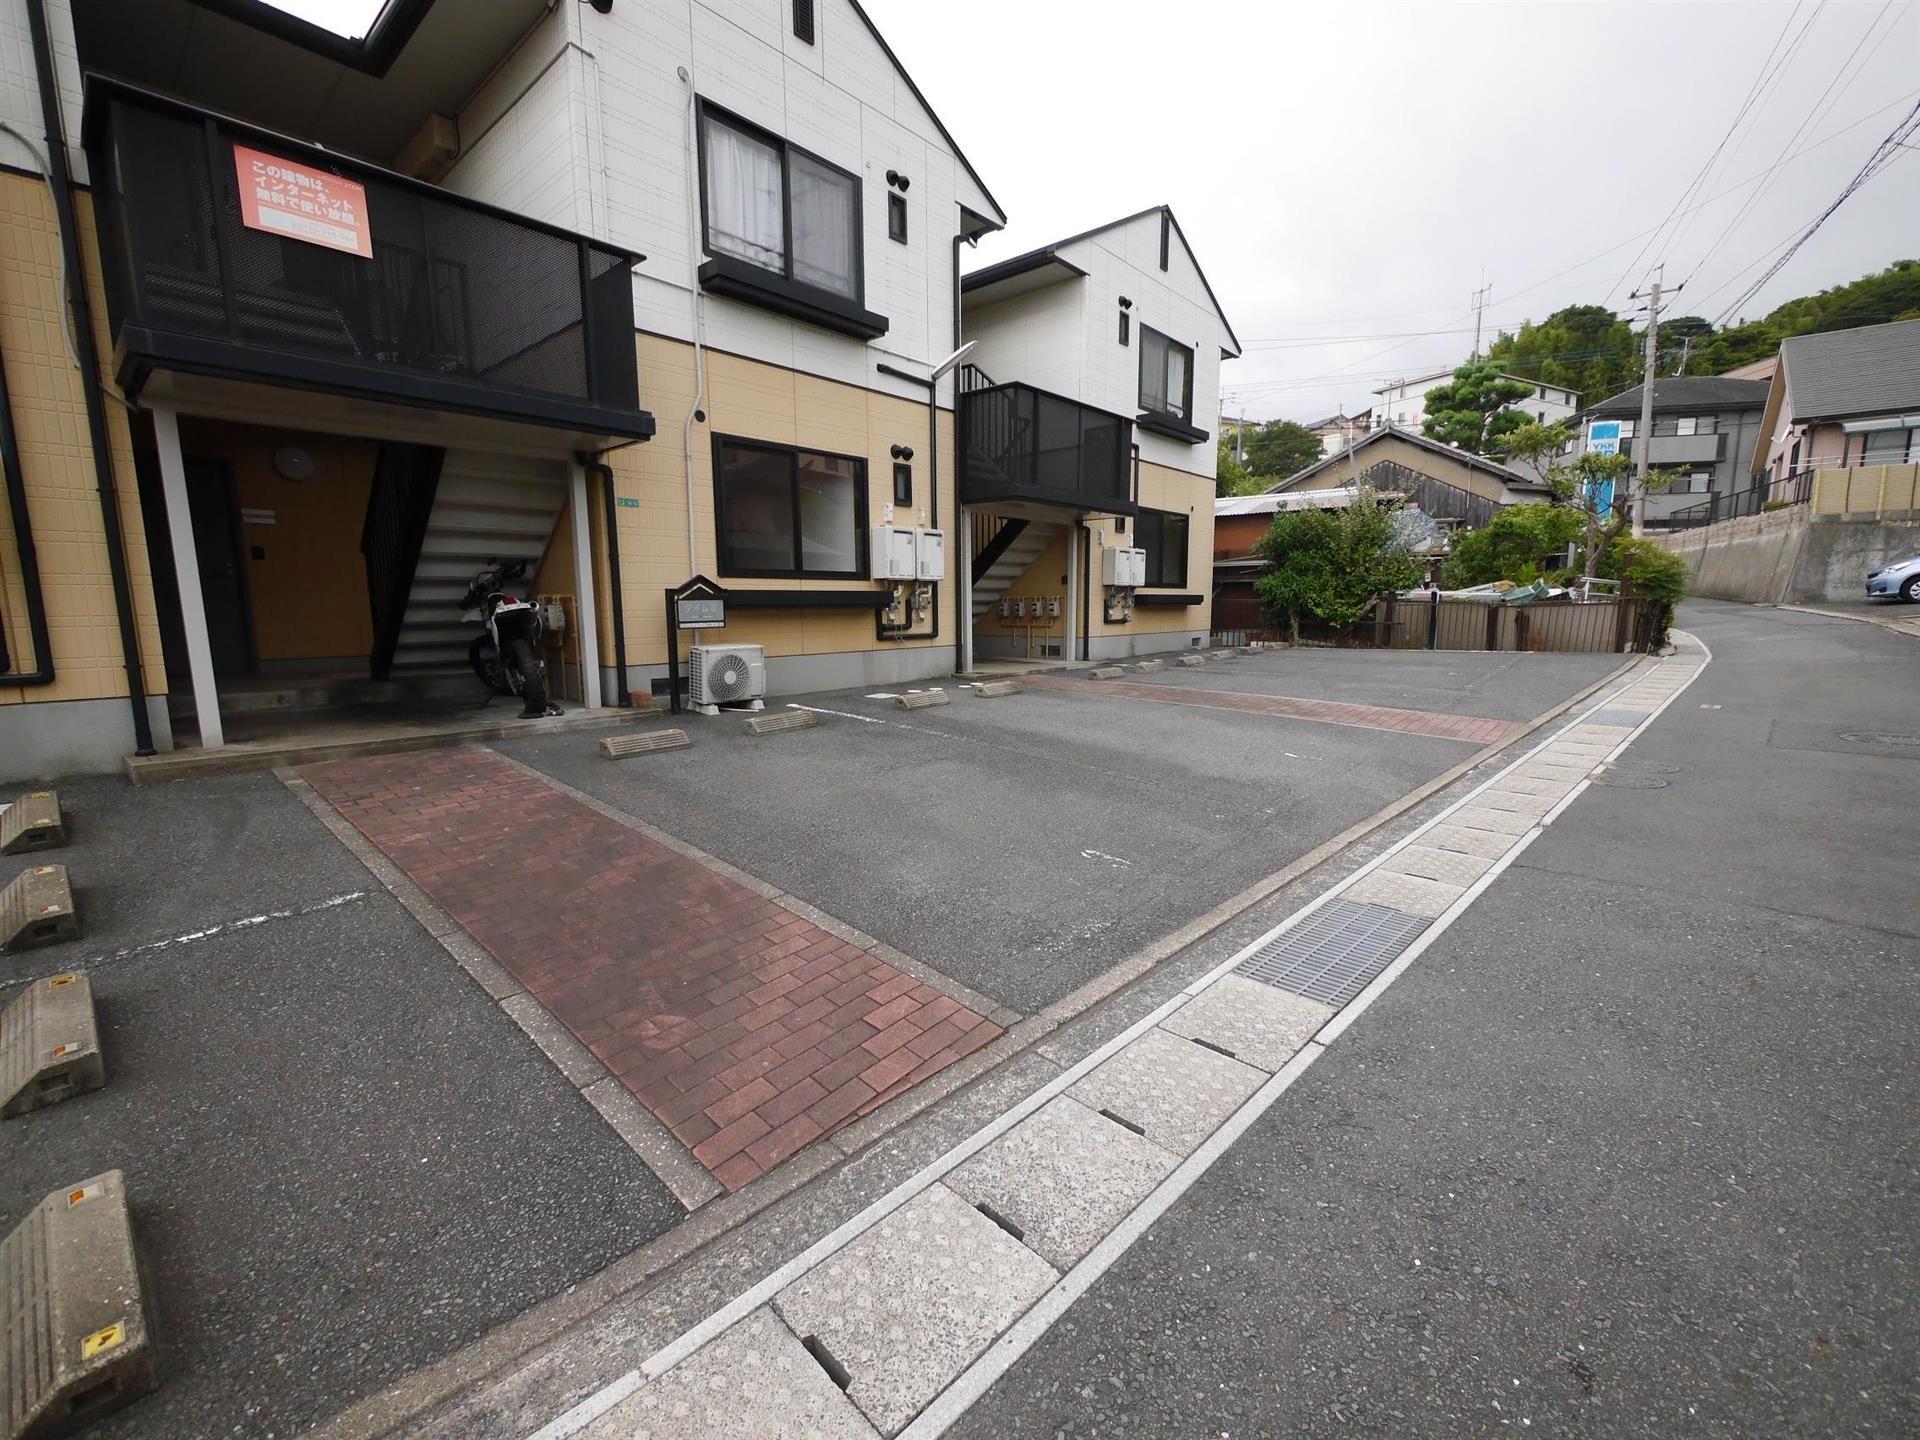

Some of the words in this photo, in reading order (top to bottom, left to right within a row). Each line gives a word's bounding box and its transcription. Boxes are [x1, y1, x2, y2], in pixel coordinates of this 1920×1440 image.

[252, 161, 329, 193] この建物は、
[255, 176, 353, 211] インターネット
[1592, 442, 1615, 450] YKK
